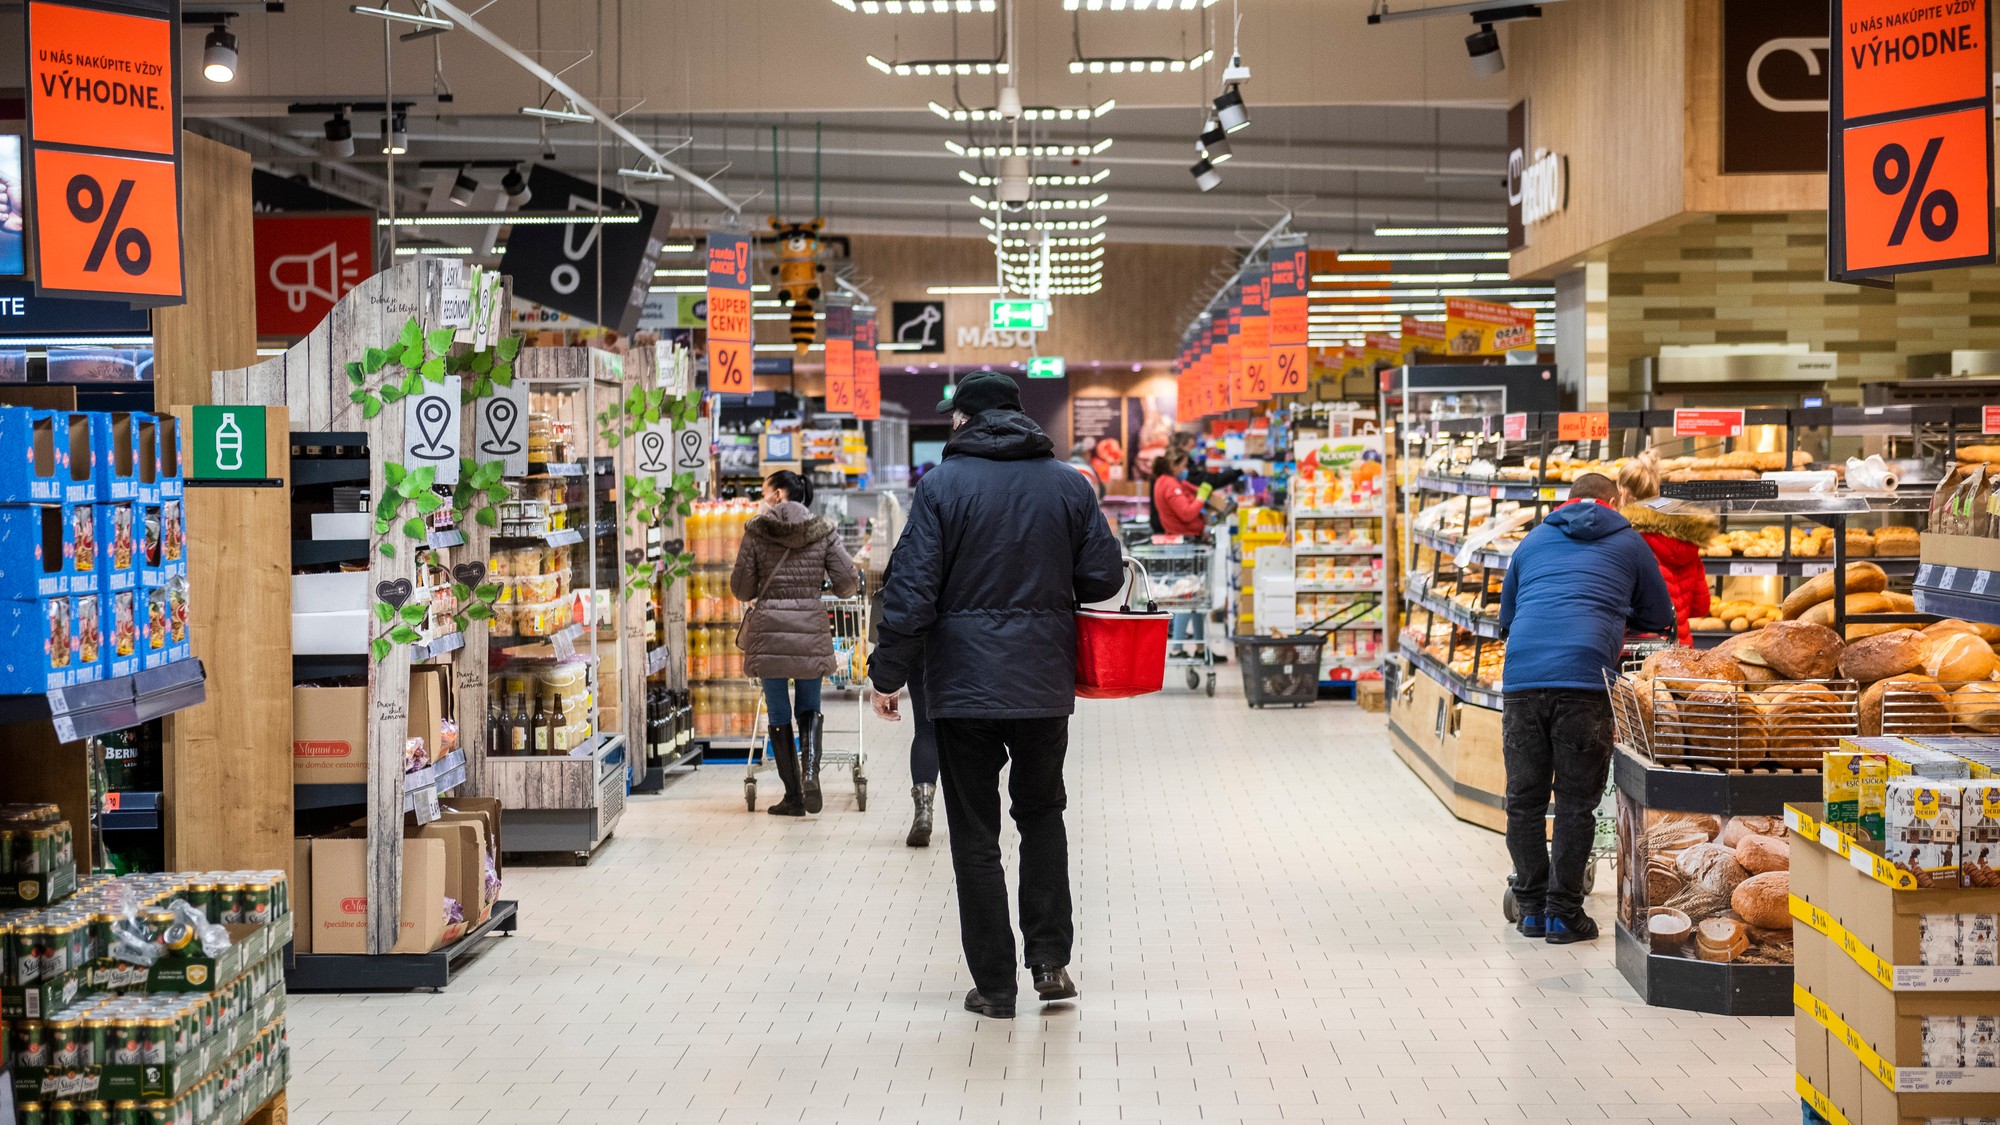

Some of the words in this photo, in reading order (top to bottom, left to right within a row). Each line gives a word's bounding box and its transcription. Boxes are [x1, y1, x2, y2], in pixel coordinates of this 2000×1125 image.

[1850, 23, 1857, 34] U
[1861, 17, 1882, 33] NÁS
[1886, 8, 1942, 28] NAKÚPITE
[1945, 0, 1977, 15] VŽDY
[1851, 24, 1978, 70] VÝHODNE.
[40, 50, 47, 61] U
[50, 50, 73, 65] NÁS
[76, 55, 131, 73] NAKÚPITE
[135, 61, 163, 77] VŽDY
[41, 70, 164, 111] VÝHODNE.
[711, 296, 747, 314] SUPER
[711, 314, 748, 333] CENY!
[1861, 777, 1884, 785] ESÍČKA
[323, 919, 355, 929] špeciálne
